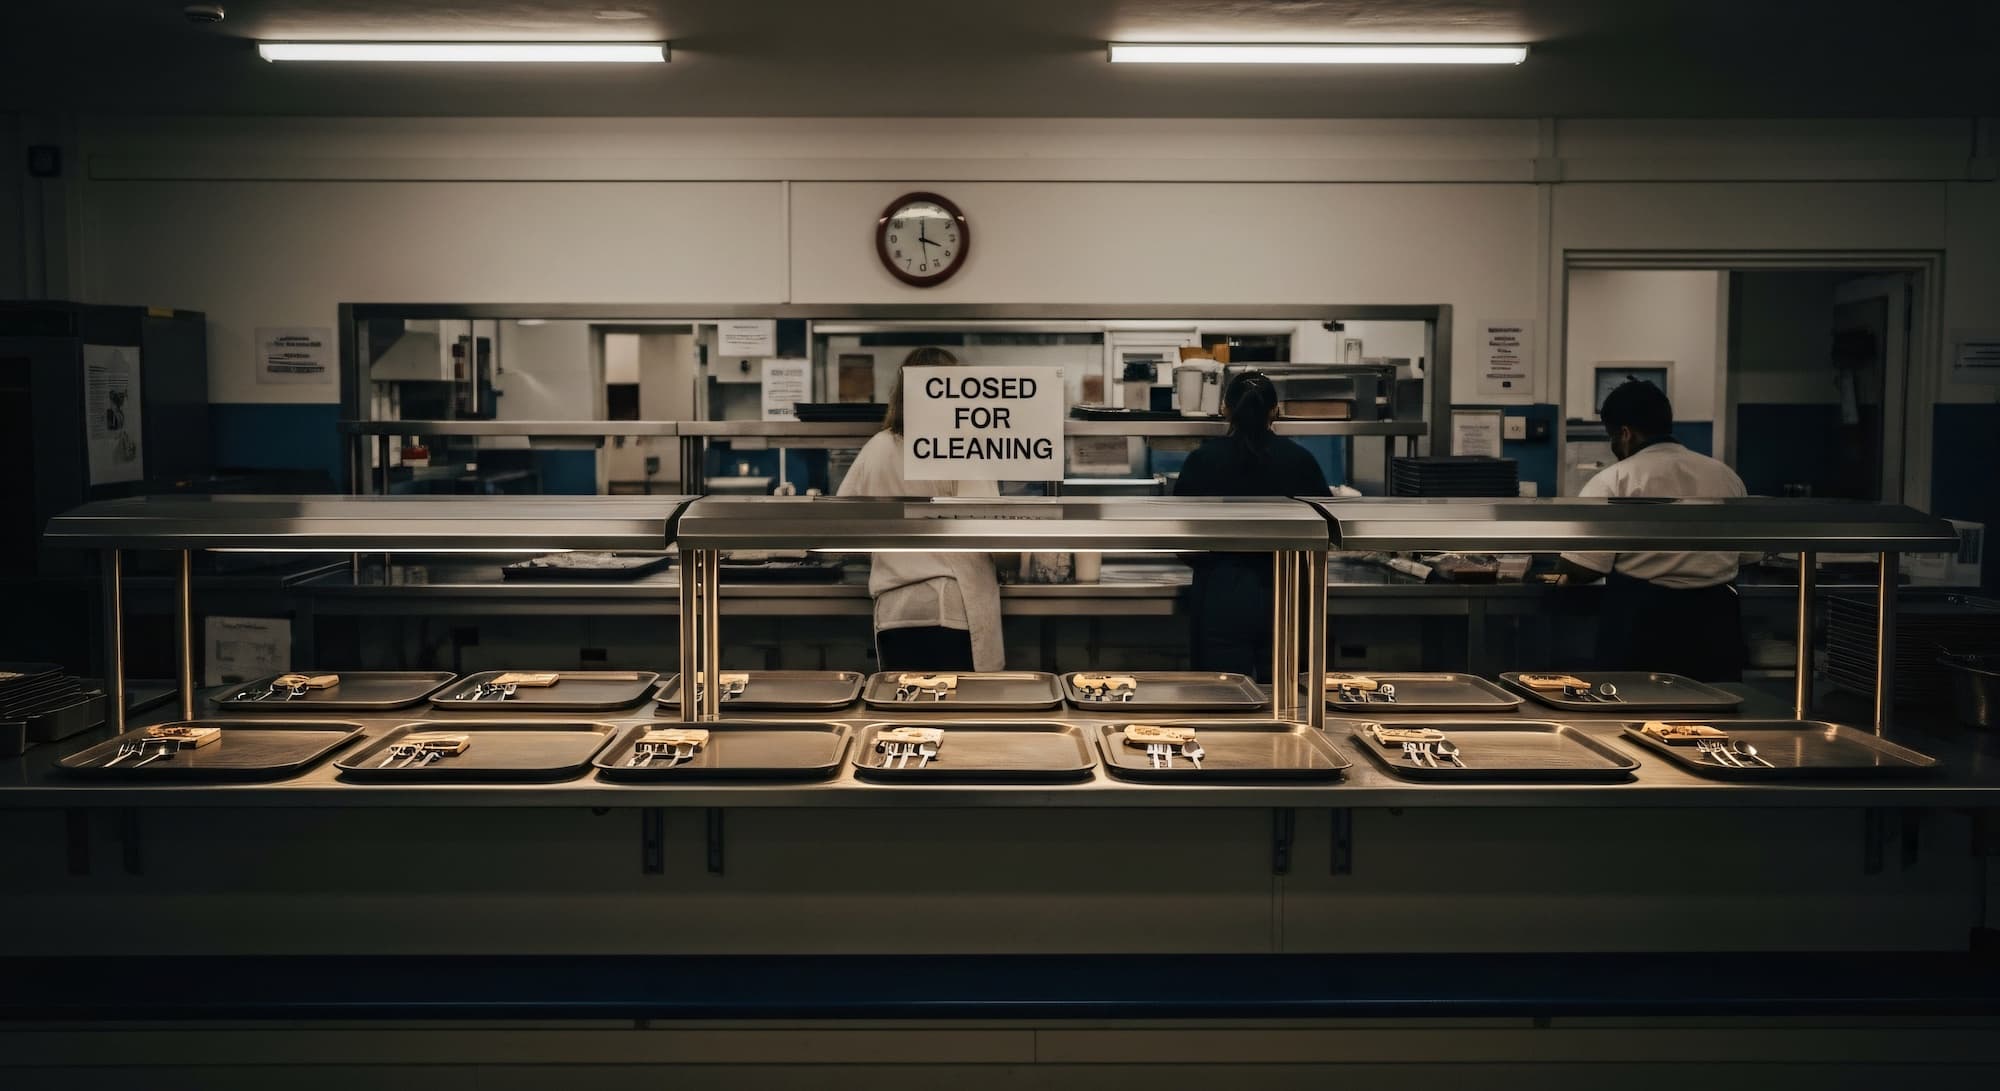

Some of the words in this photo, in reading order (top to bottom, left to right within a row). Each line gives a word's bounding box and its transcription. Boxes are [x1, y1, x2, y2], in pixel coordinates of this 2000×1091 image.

[925, 376, 1037, 400] CLOSED
[954, 406, 1011, 430] FOR
[912, 437, 1053, 460] CLEANING
